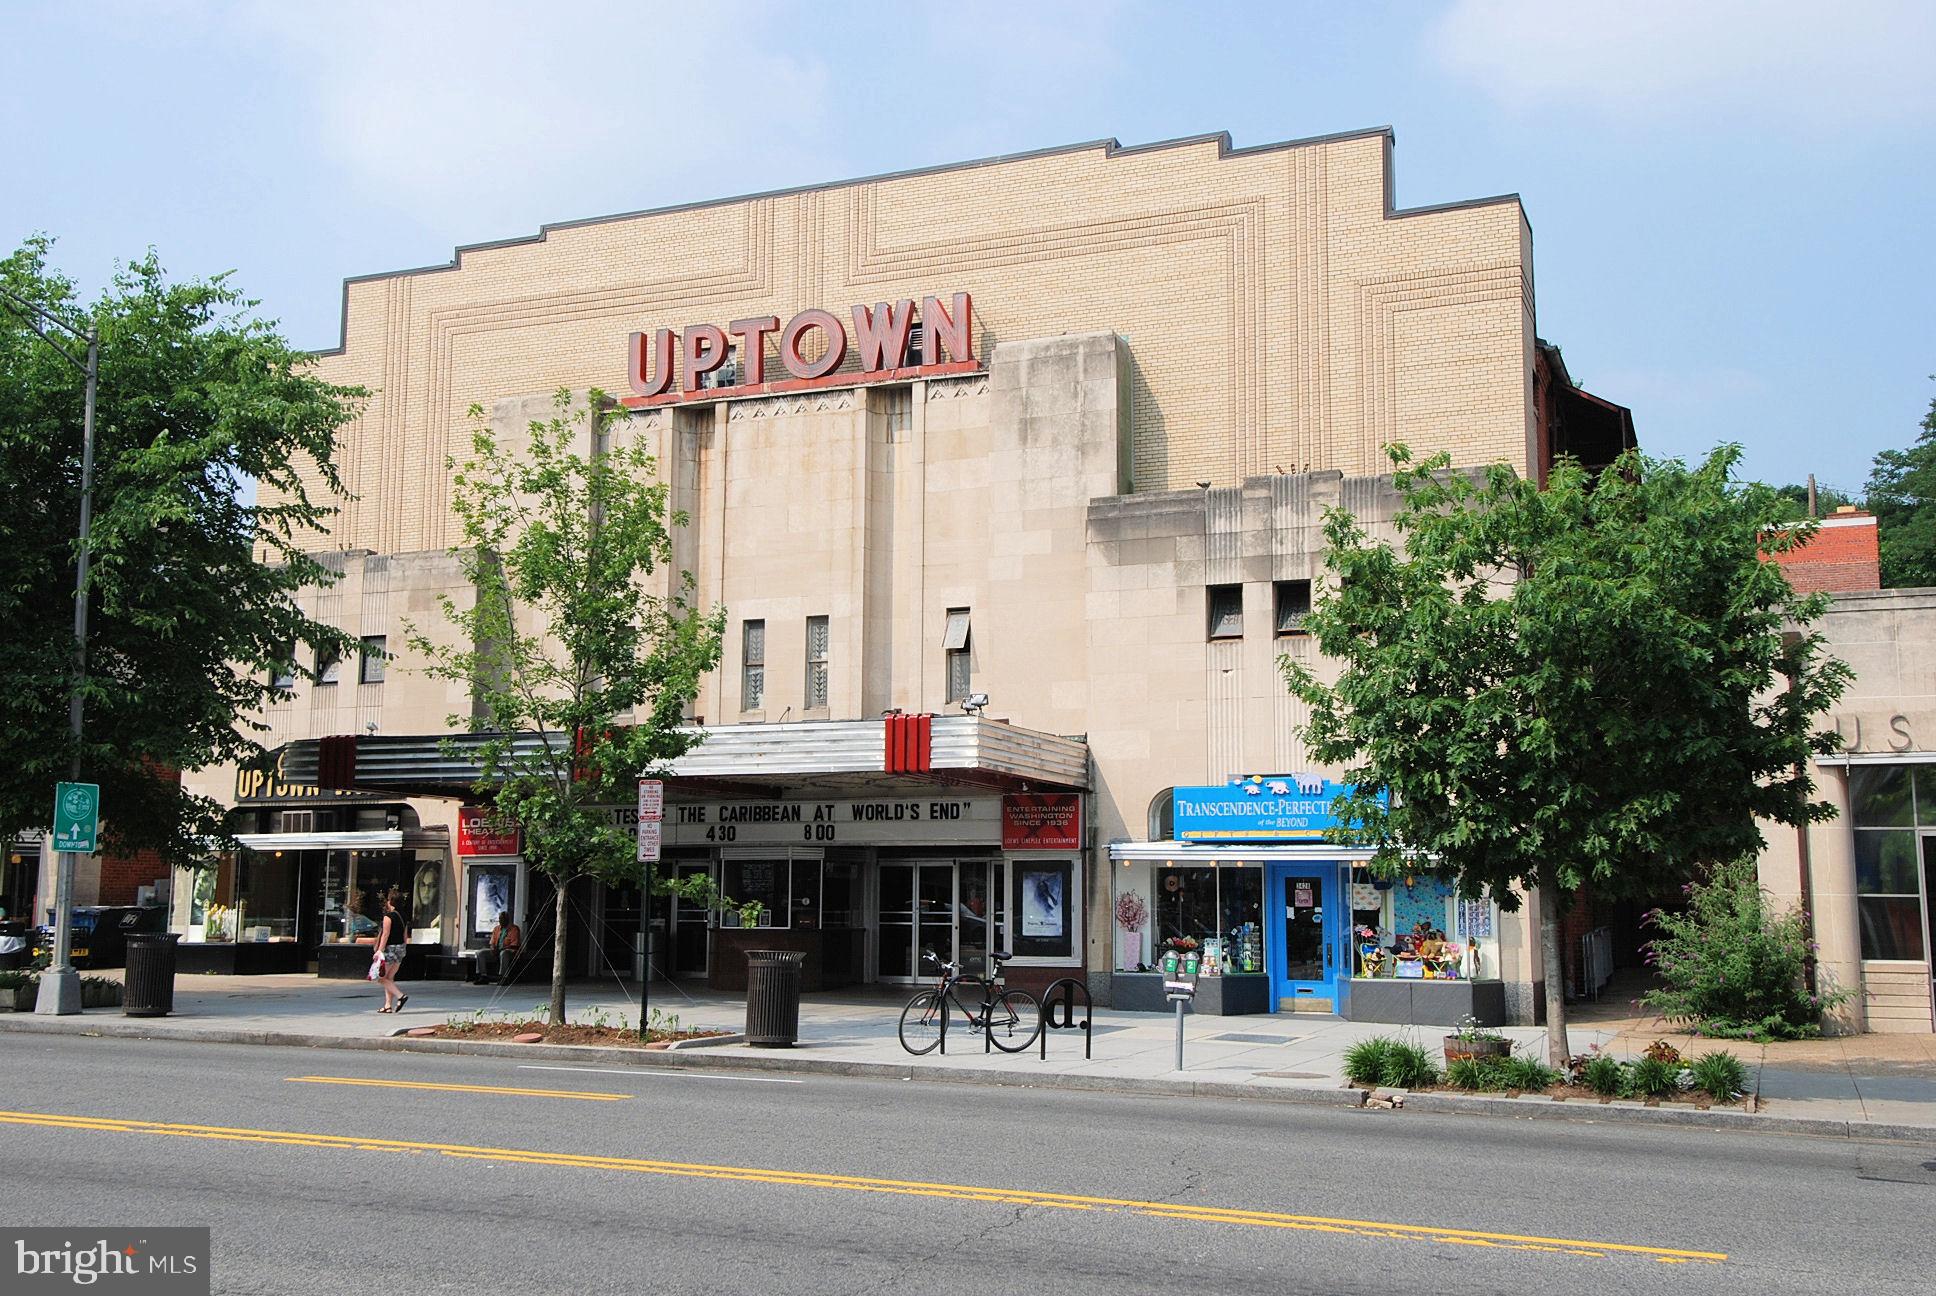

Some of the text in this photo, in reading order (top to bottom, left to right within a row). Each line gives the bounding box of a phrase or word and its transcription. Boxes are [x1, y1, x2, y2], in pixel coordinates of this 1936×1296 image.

[628, 292, 972, 396] UPTOWN
[678, 806, 706, 823] THE
[719, 804, 801, 823] CARIBBEAN
[813, 804, 835, 821] AT
[852, 803, 920, 821] WORLD'S
[1006, 805, 1076, 813] ENTERTAINING
[1276, 817, 1308, 827] BEYOND
[59, 841, 90, 849] DOWNTO
